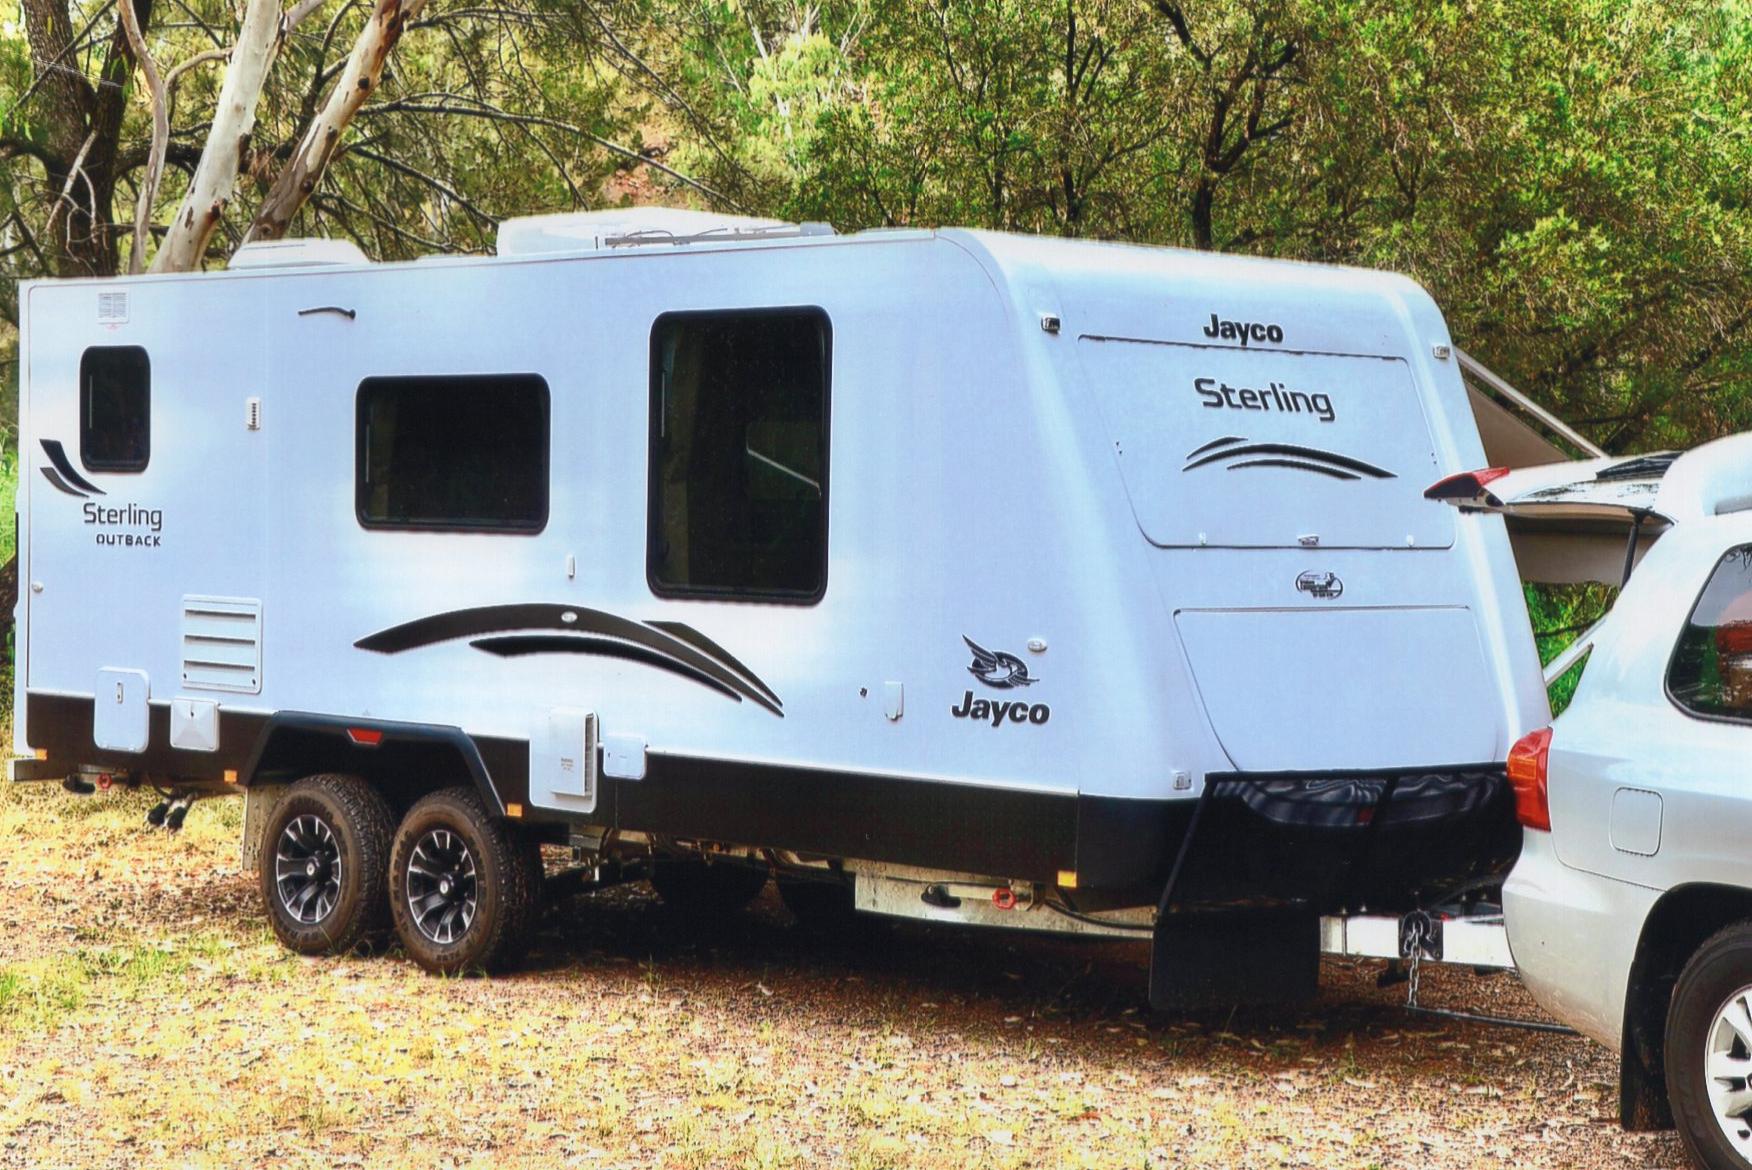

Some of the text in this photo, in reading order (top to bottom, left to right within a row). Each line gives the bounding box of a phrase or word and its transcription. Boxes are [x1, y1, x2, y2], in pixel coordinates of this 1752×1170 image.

[1203, 313, 1284, 346] Jayco
[1194, 378, 1336, 422] Sterling
[83, 502, 162, 532] Sterling
[96, 533, 161, 547] OUTBACK
[951, 690, 1050, 728] Jayco
